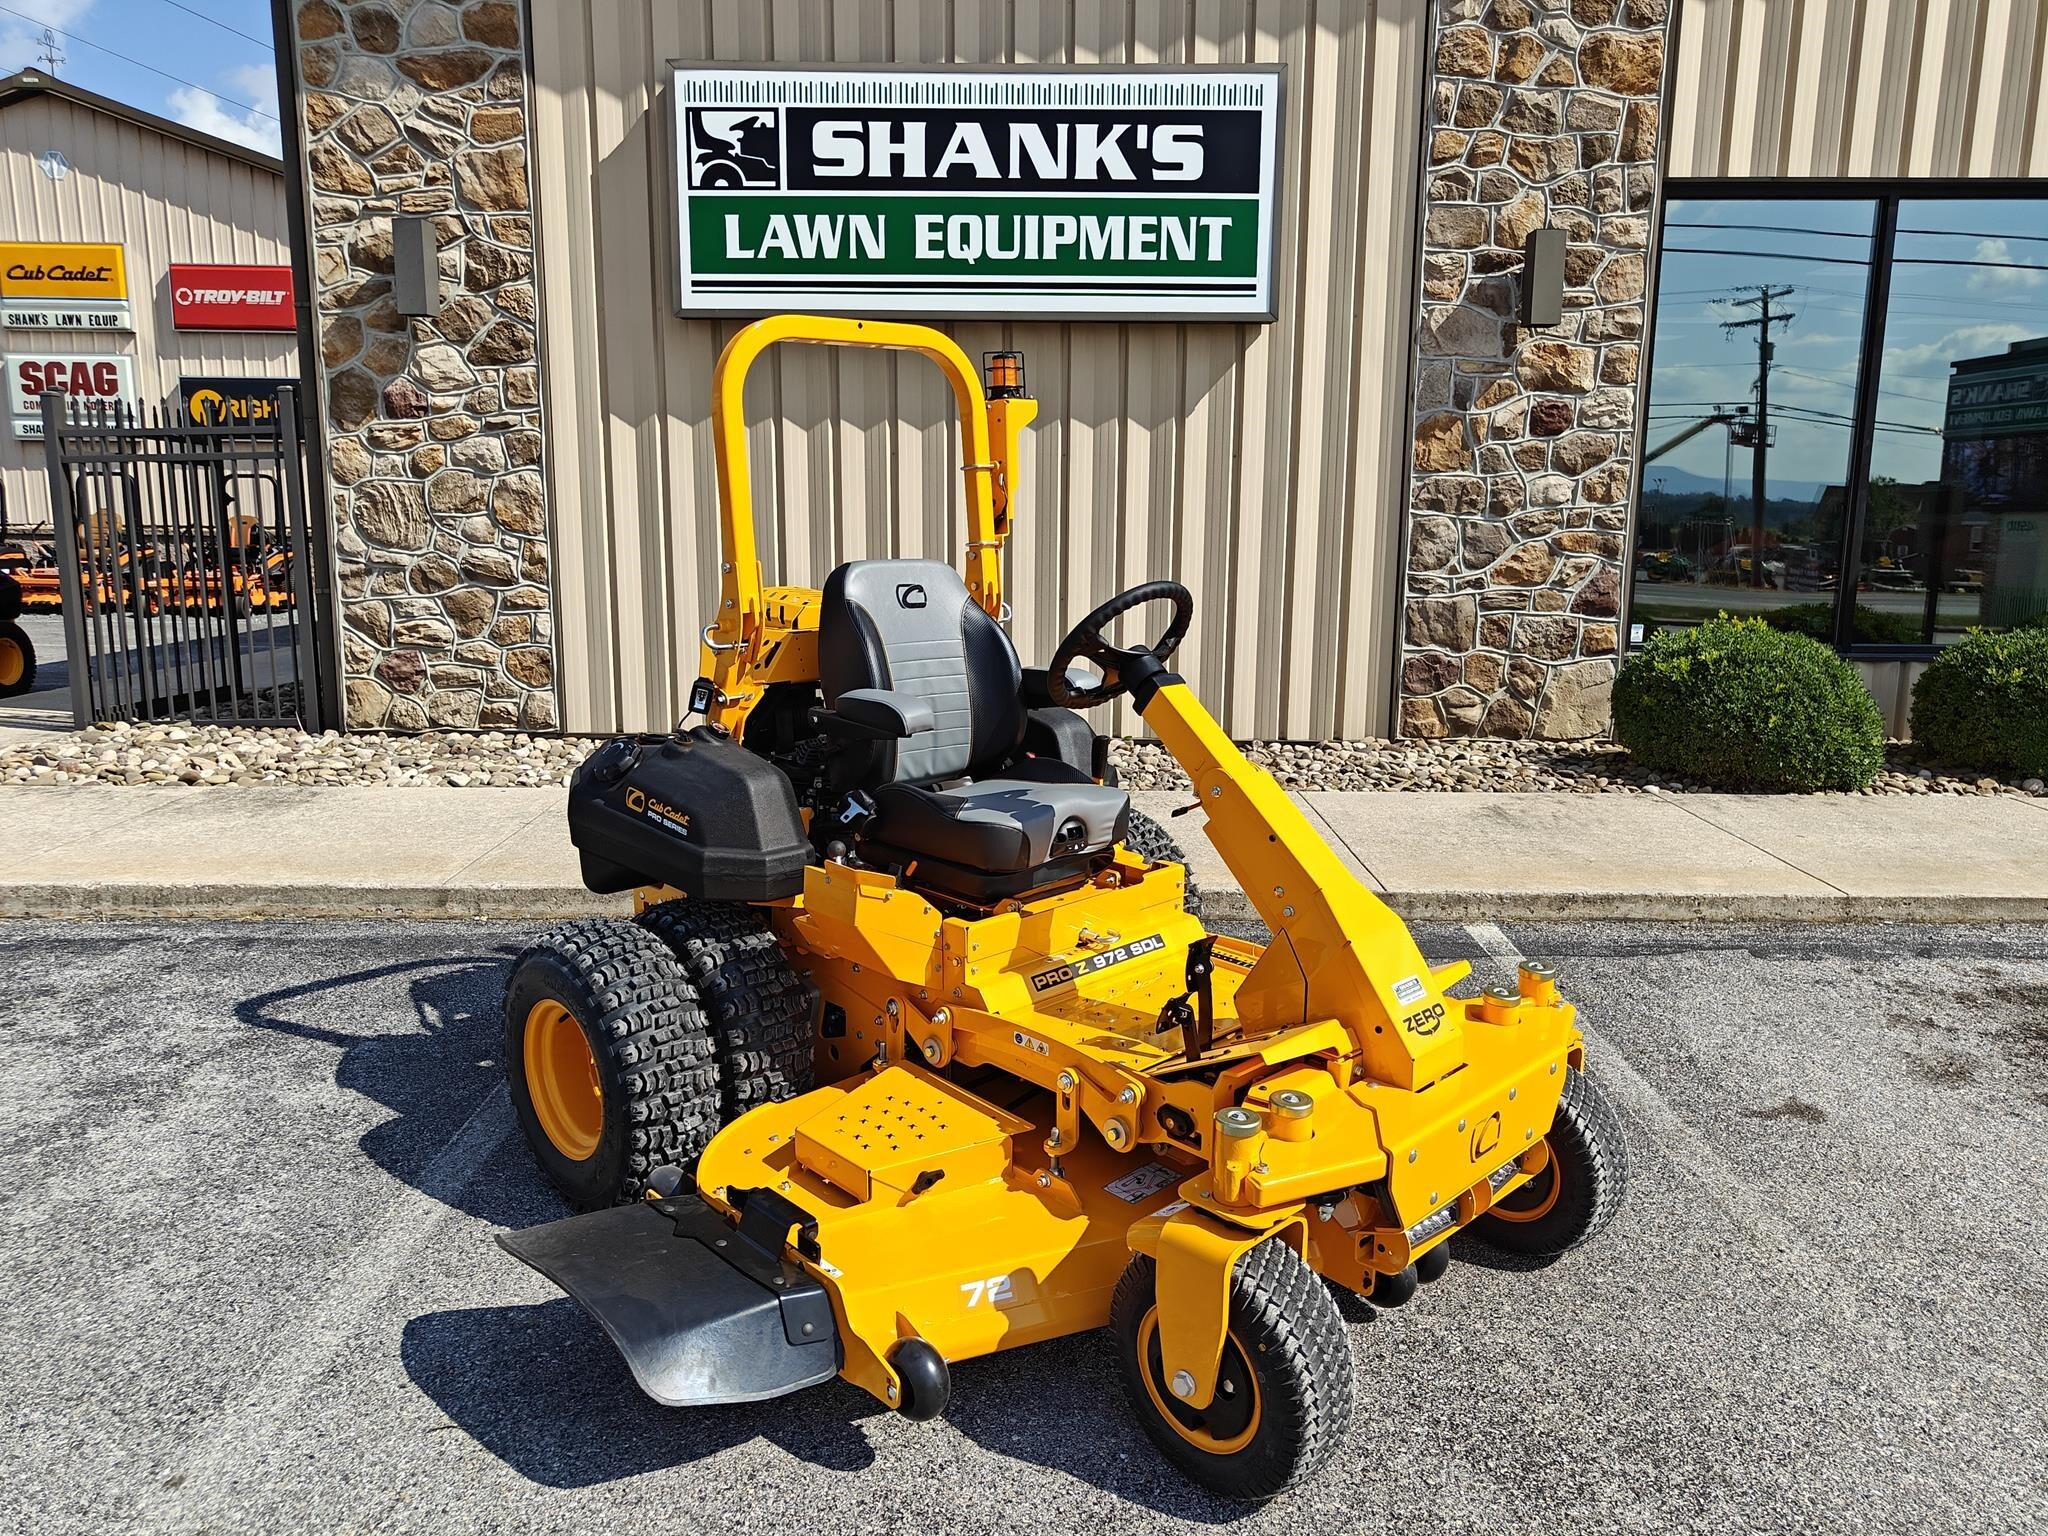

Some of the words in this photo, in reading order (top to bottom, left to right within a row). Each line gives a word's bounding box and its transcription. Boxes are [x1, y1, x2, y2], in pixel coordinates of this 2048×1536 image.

[811, 120, 1205, 182] SHANK'S
[723, 213, 887, 261] LAWN
[914, 214, 1233, 265] EQUIPMENT
[6, 264, 46, 281] Cub
[46, 266, 112, 282] Cadet
[193, 289, 287, 305] TROY-BILT
[8, 312, 49, 326] SHANK'S
[55, 314, 82, 327] LAWN
[89, 314, 119, 327] EQUIP
[19, 361, 119, 396] SCAG
[647, 810, 662, 823] PRO
[663, 818, 687, 836] SERIES
[648, 798, 664, 814] Cub
[664, 807, 690, 825] Cadet
[1033, 966, 1073, 990] PRO
[1075, 961, 1090, 974] Z
[1094, 950, 1128, 969] 972
[1131, 937, 1164, 956] SDL
[1402, 1002, 1446, 1033] ZERO
[959, 1274, 1014, 1309] 72
